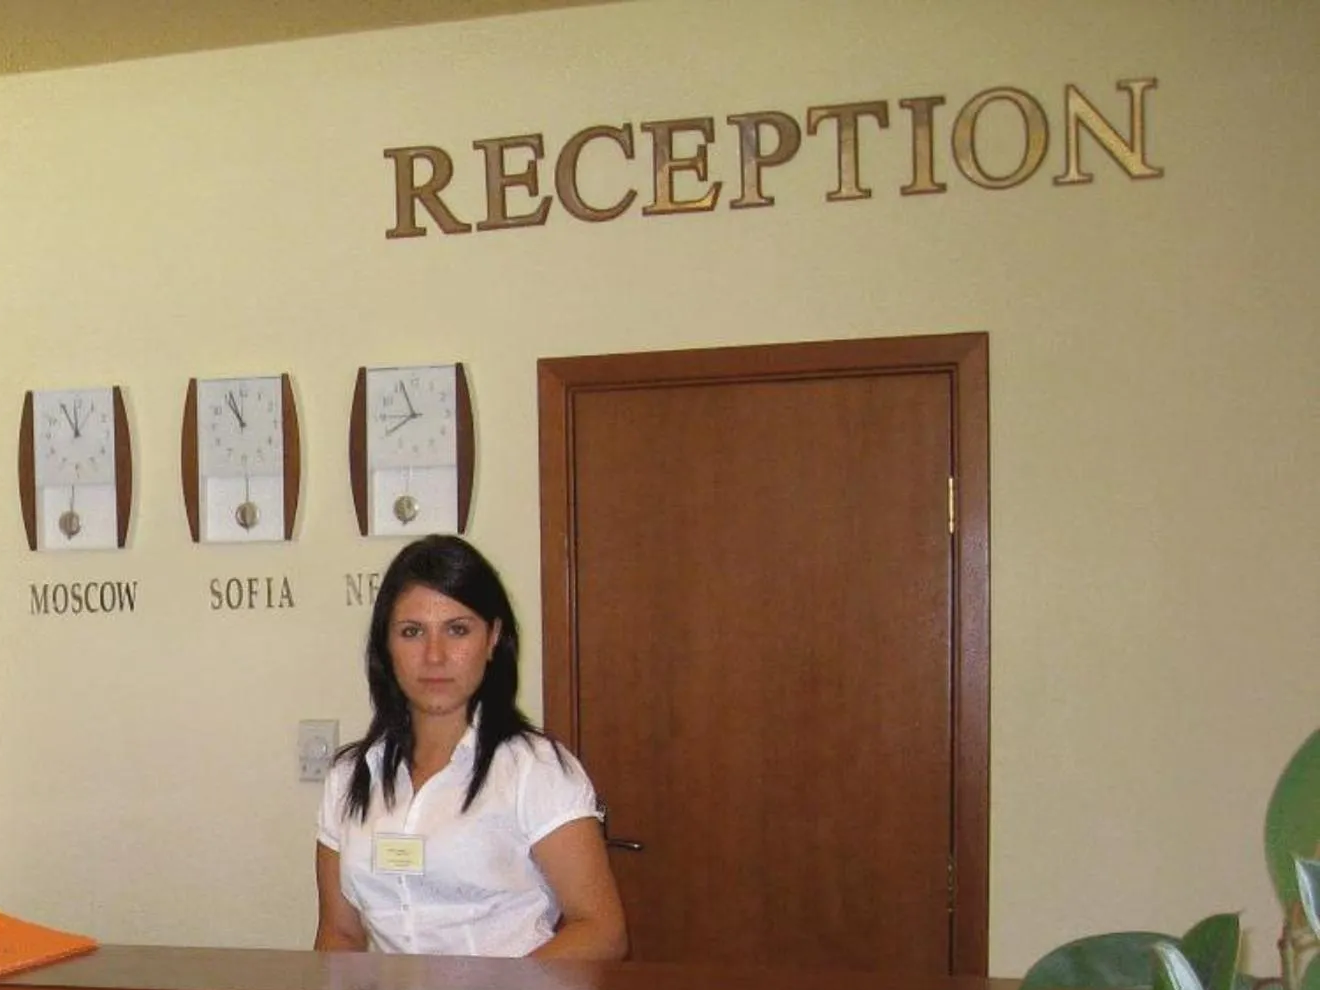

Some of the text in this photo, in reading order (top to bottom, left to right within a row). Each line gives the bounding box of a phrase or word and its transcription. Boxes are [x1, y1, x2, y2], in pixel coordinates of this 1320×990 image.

[383, 76, 1164, 240] RECEPTION
[30, 580, 138, 616] MOSCOW
[209, 576, 295, 610] SOFIA
